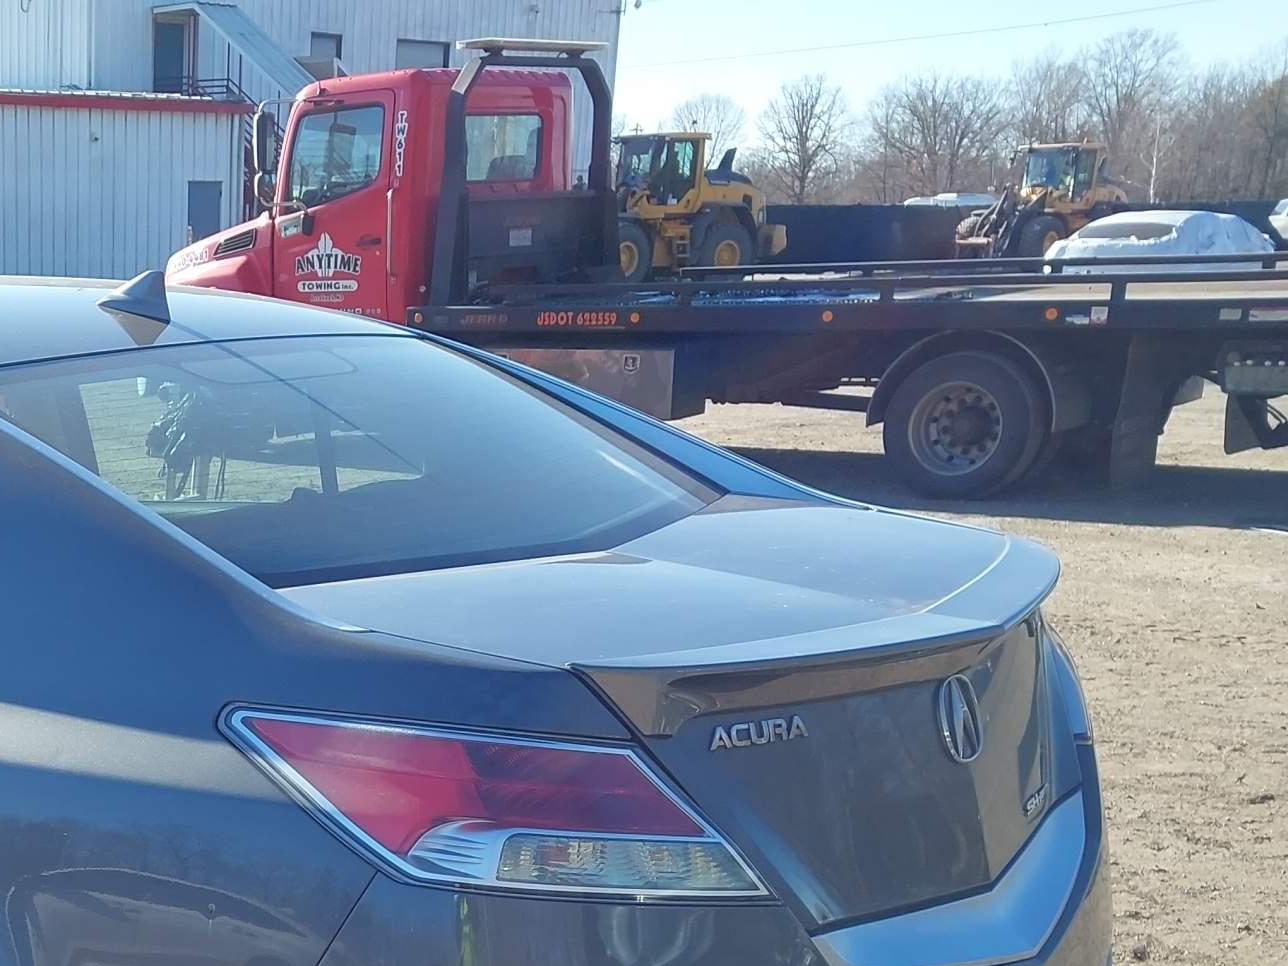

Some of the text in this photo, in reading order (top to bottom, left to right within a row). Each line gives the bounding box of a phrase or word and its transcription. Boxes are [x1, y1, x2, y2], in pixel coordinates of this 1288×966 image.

[296, 253, 362, 275] ANYTIME
[302, 281, 340, 291] TOWING
[710, 715, 809, 751] ACURA
